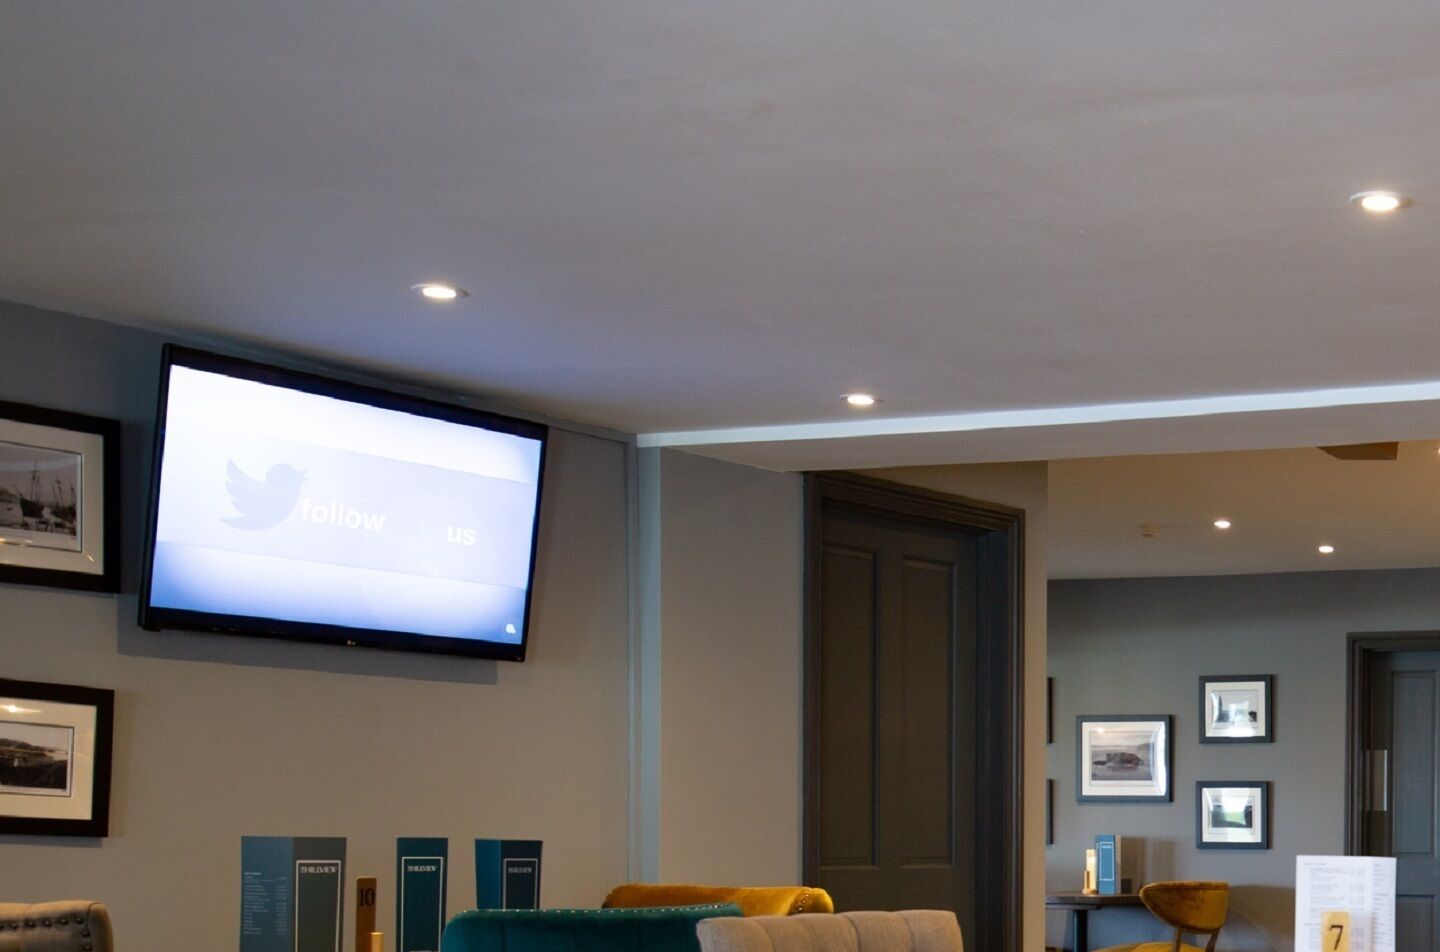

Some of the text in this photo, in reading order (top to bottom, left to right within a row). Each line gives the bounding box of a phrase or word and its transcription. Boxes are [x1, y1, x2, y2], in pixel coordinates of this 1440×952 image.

[301, 498, 477, 546] follow us
[358, 888, 375, 906] 10
[1329, 924, 1344, 951] 7
